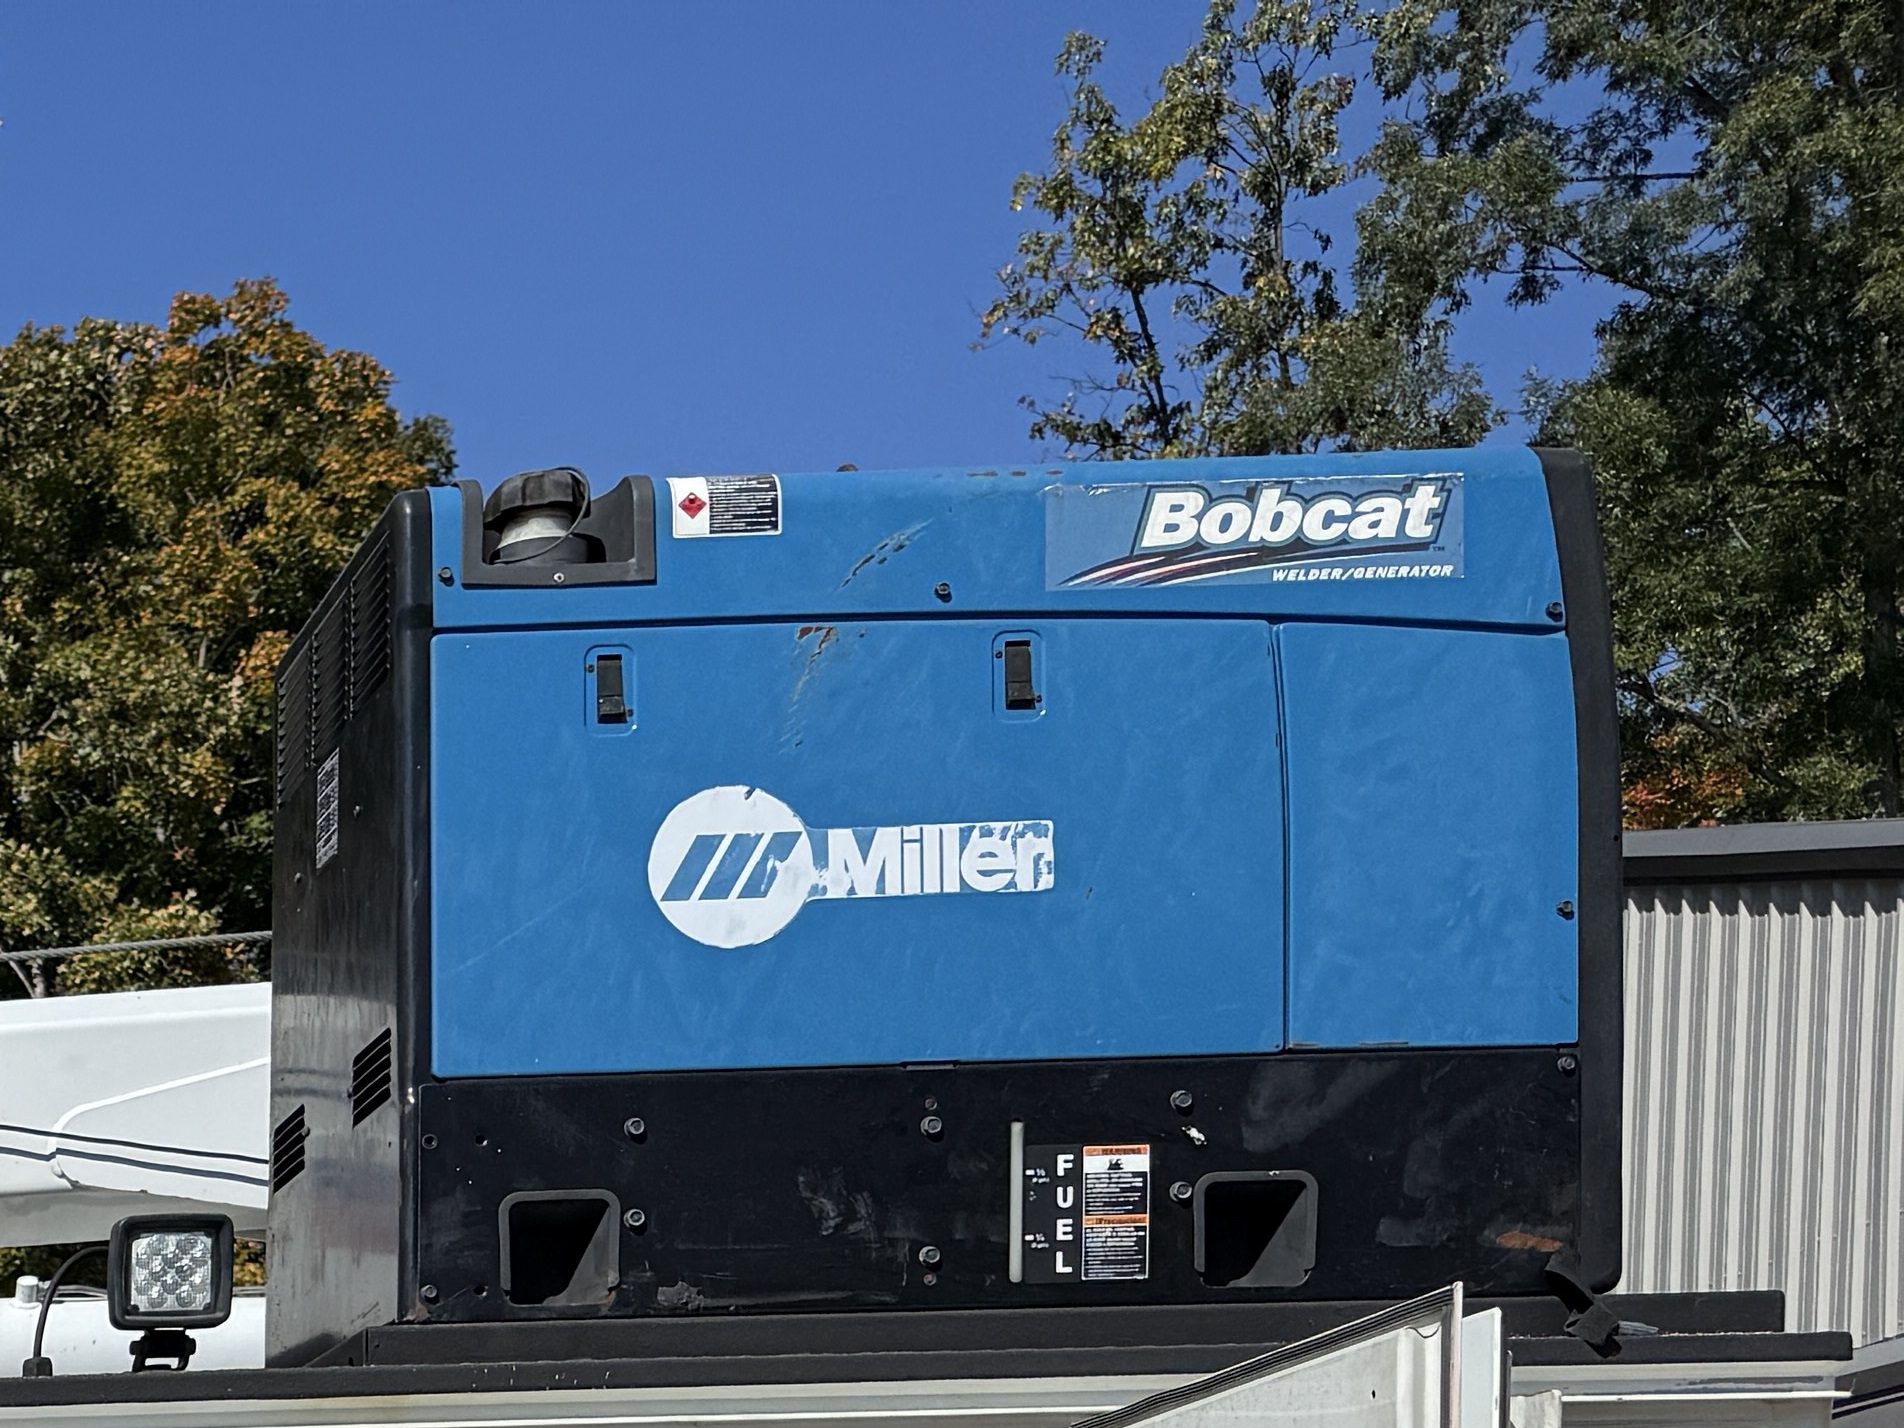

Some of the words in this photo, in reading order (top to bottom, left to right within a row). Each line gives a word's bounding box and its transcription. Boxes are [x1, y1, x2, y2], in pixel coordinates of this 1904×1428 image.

[1139, 484, 1444, 549] Bobcat
[1272, 564, 1455, 582] WELDER/GENERATOR
[828, 823, 1053, 896] Miller
[1055, 1153, 1075, 1274] FUEL
